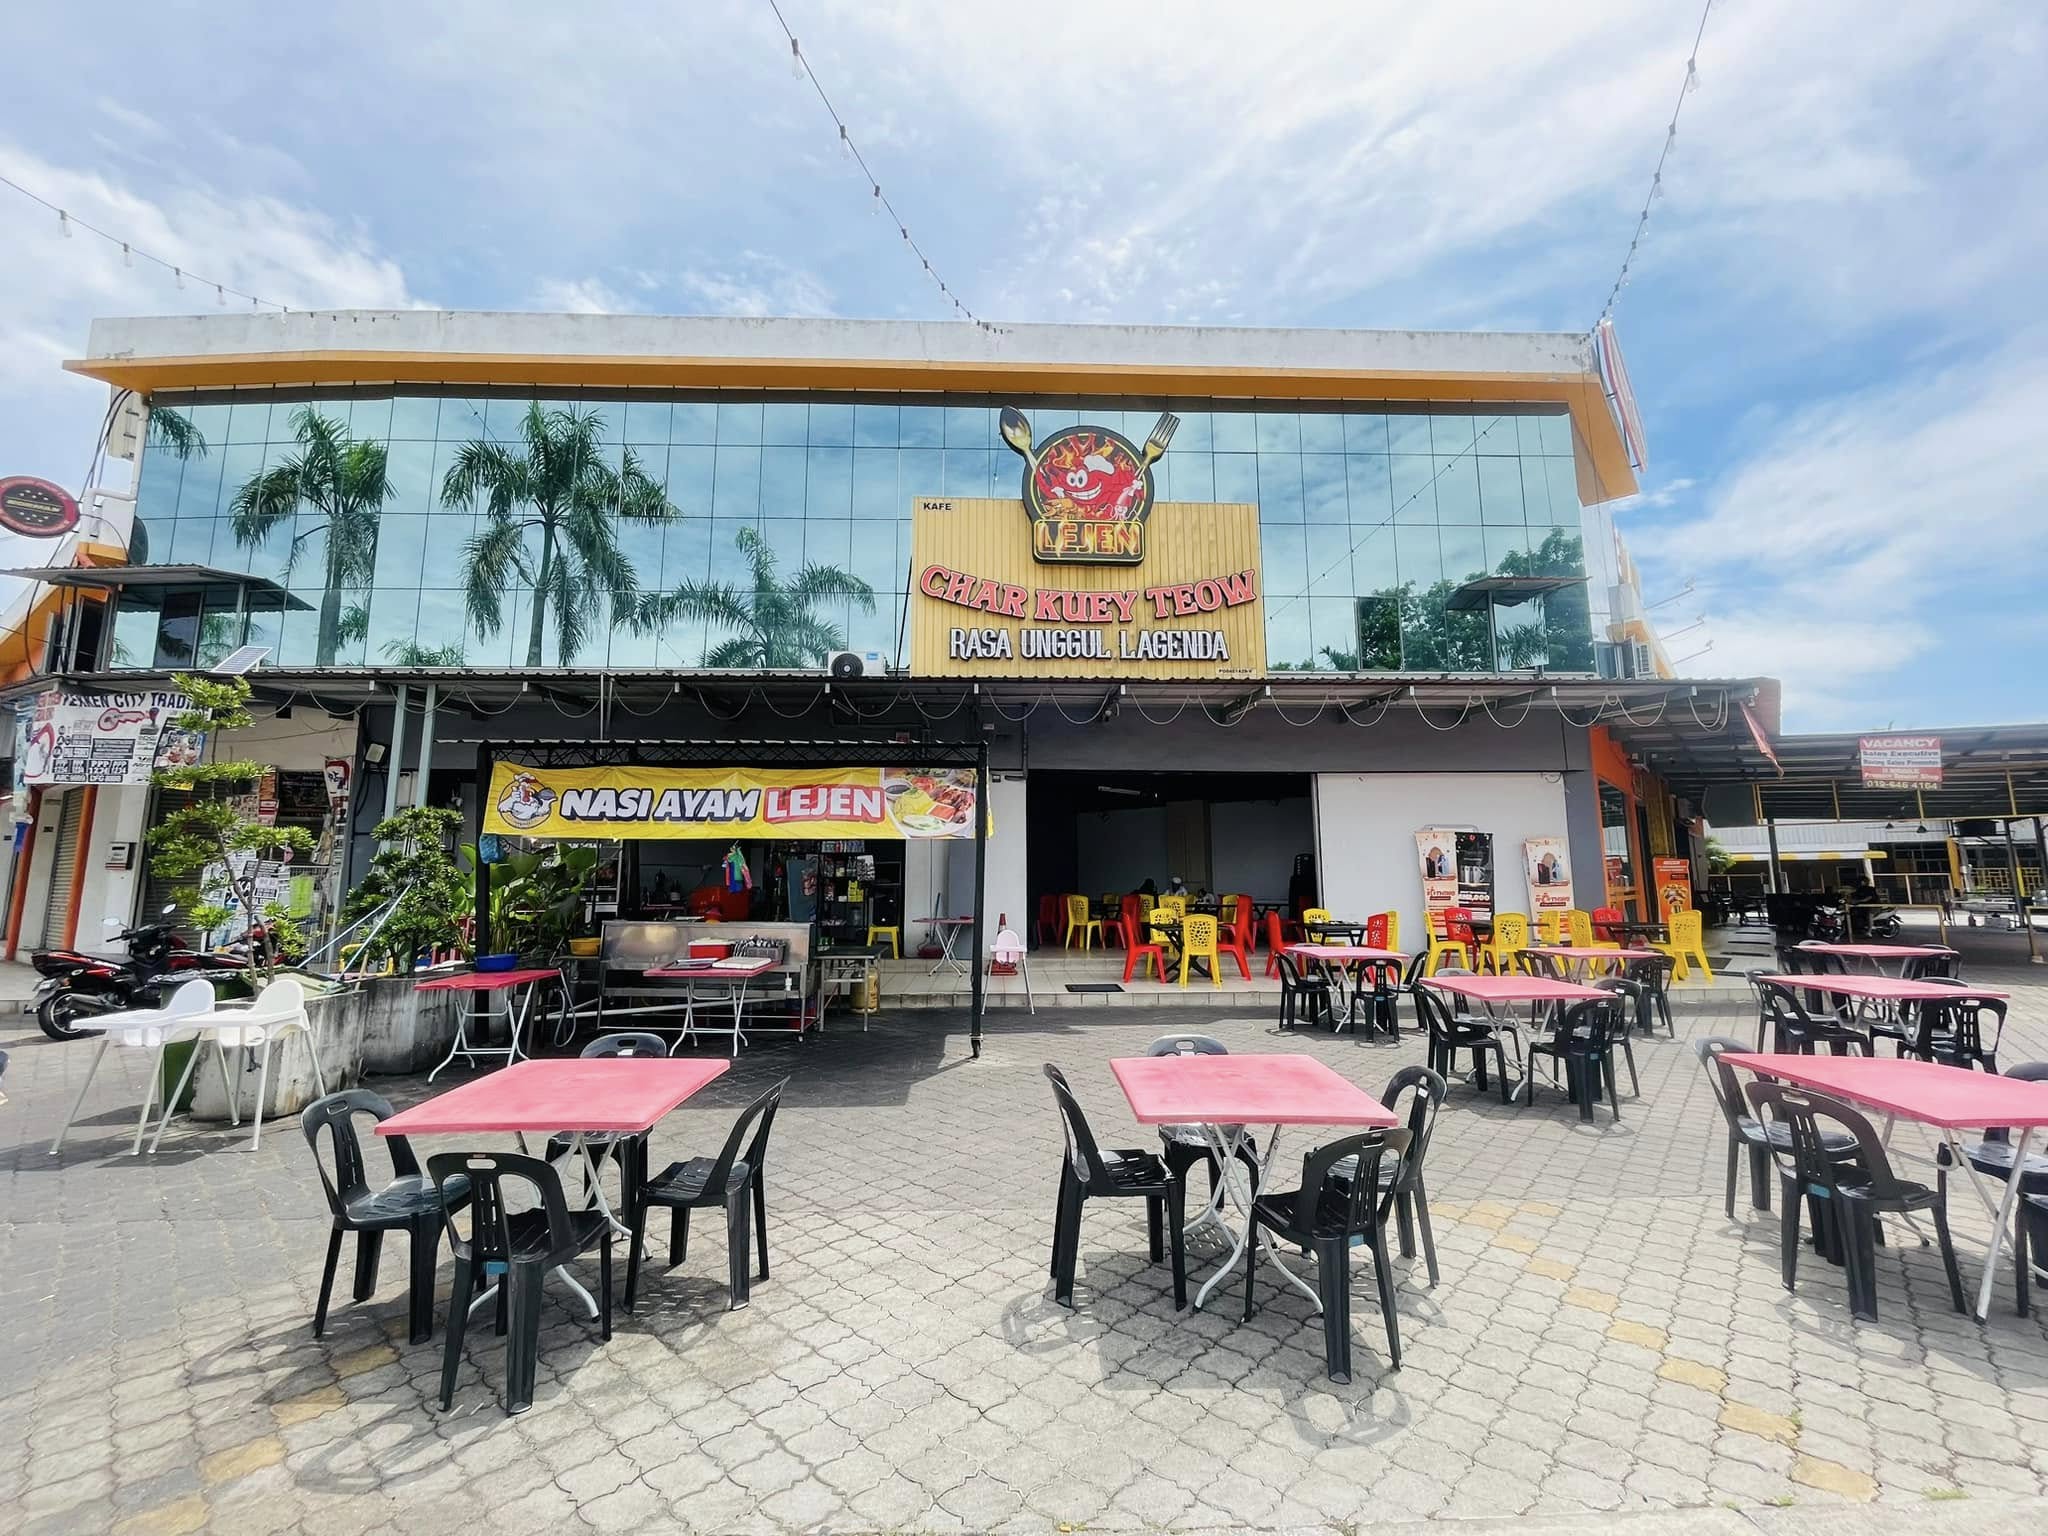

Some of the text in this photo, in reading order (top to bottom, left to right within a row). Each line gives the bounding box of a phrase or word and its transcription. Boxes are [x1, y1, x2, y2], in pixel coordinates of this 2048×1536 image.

[923, 502, 952, 511] KAFE
[1039, 521, 1140, 556] LEJEN
[920, 564, 1256, 624] CHAR KUEY TEOW
[950, 627, 1229, 661] RASA UNGGUL LAGENDA
[114, 693, 146, 708] CITY
[151, 691, 197, 711] TRAD
[1862, 738, 1937, 748] VACANCY
[560, 785, 884, 823] NASI AYAM LEJEN
